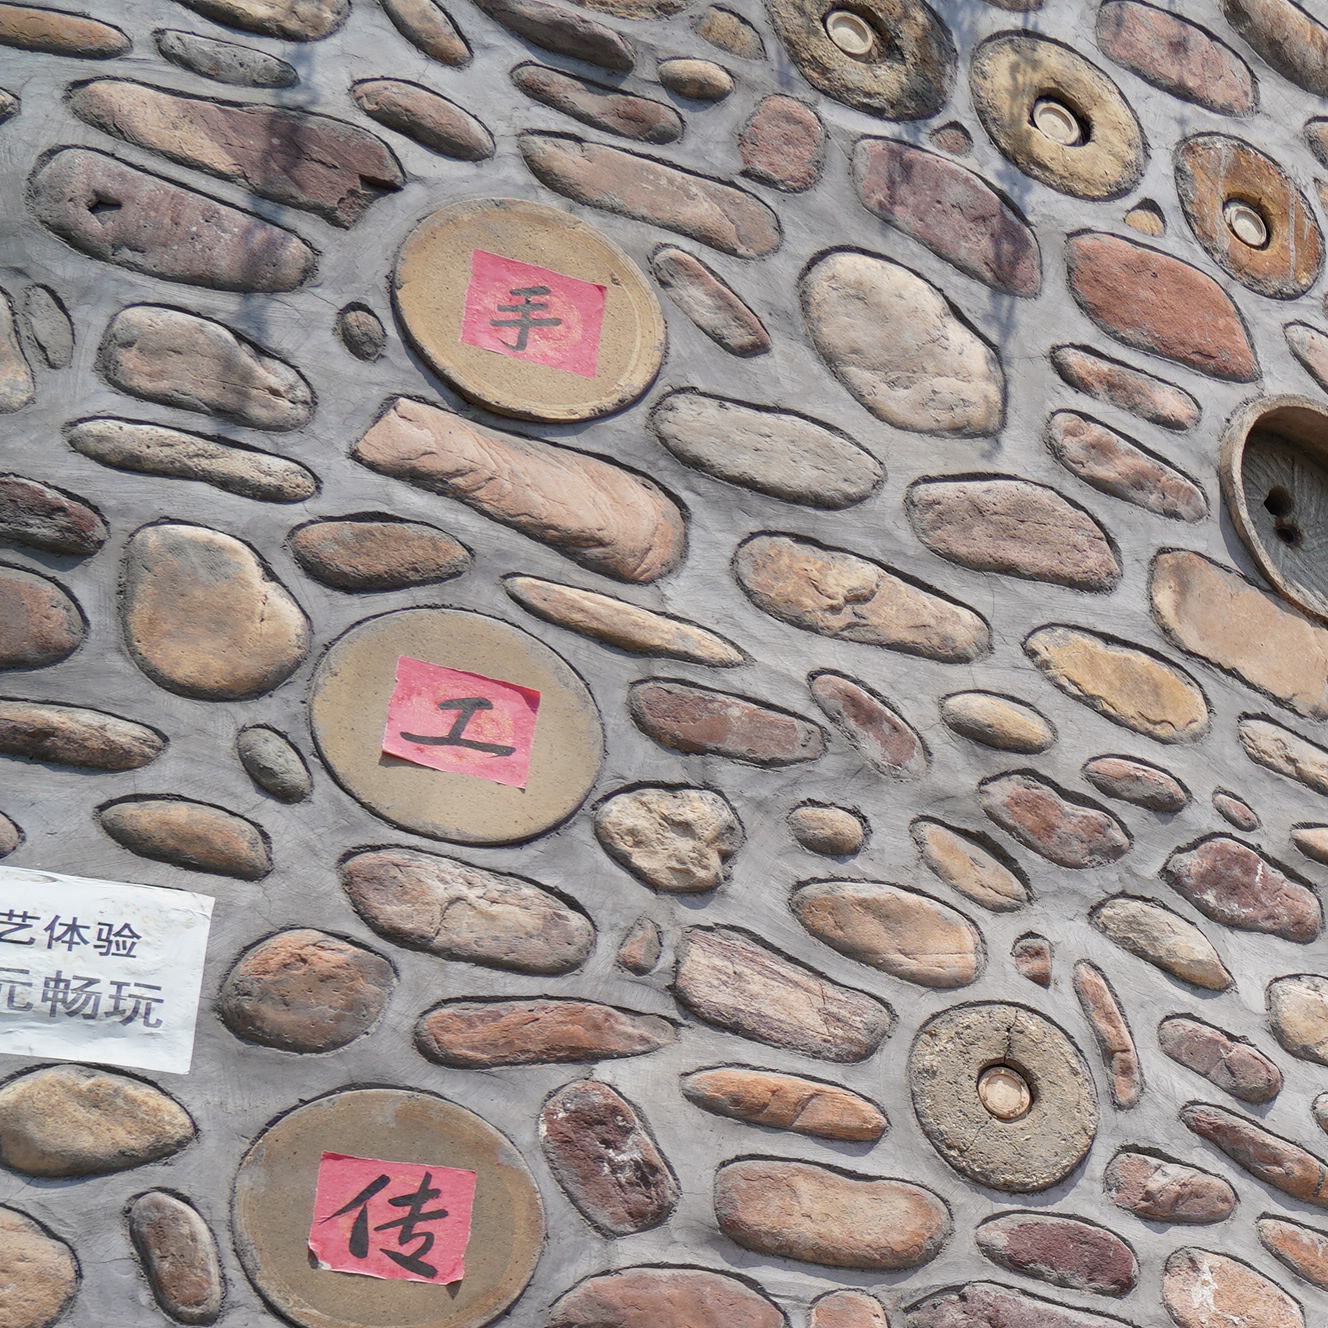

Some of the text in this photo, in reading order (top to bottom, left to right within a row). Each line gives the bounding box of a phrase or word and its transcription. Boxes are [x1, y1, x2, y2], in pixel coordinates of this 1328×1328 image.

[490, 284, 562, 351] 手
[400, 696, 516, 757] 工
[0, 909, 142, 959] 艺体验
[317, 1172, 449, 1279] 传
